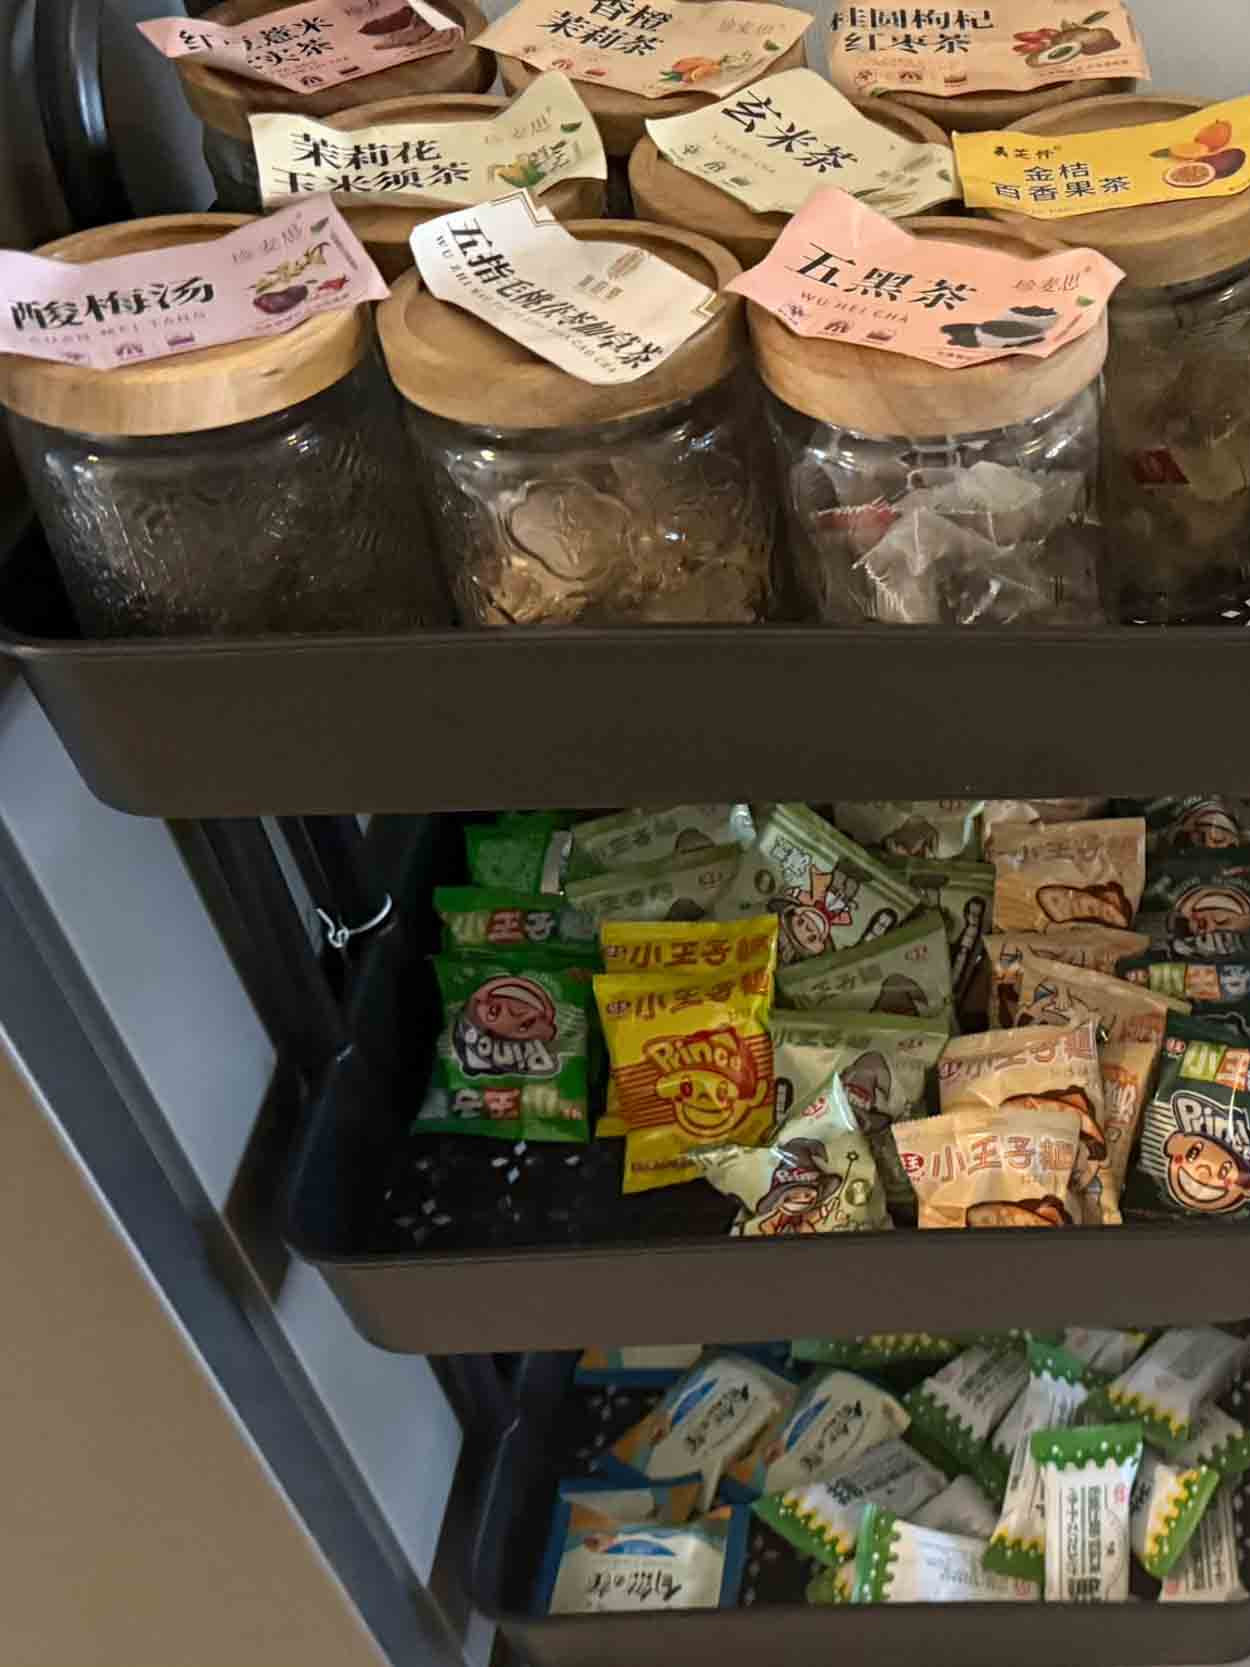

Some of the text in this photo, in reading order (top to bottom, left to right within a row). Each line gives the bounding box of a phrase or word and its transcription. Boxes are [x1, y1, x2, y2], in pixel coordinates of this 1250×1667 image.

[843, 31, 972, 55] 红枣茶
[289, 131, 443, 170] 茉莉花
[720, 89, 859, 173] 玄米茶
[990, 175, 1132, 202] 百香果茶
[1023, 161, 1091, 182] 金桔
[785, 241, 977, 311] 五黑茶
[10, 275, 216, 332] 酸梅汤
